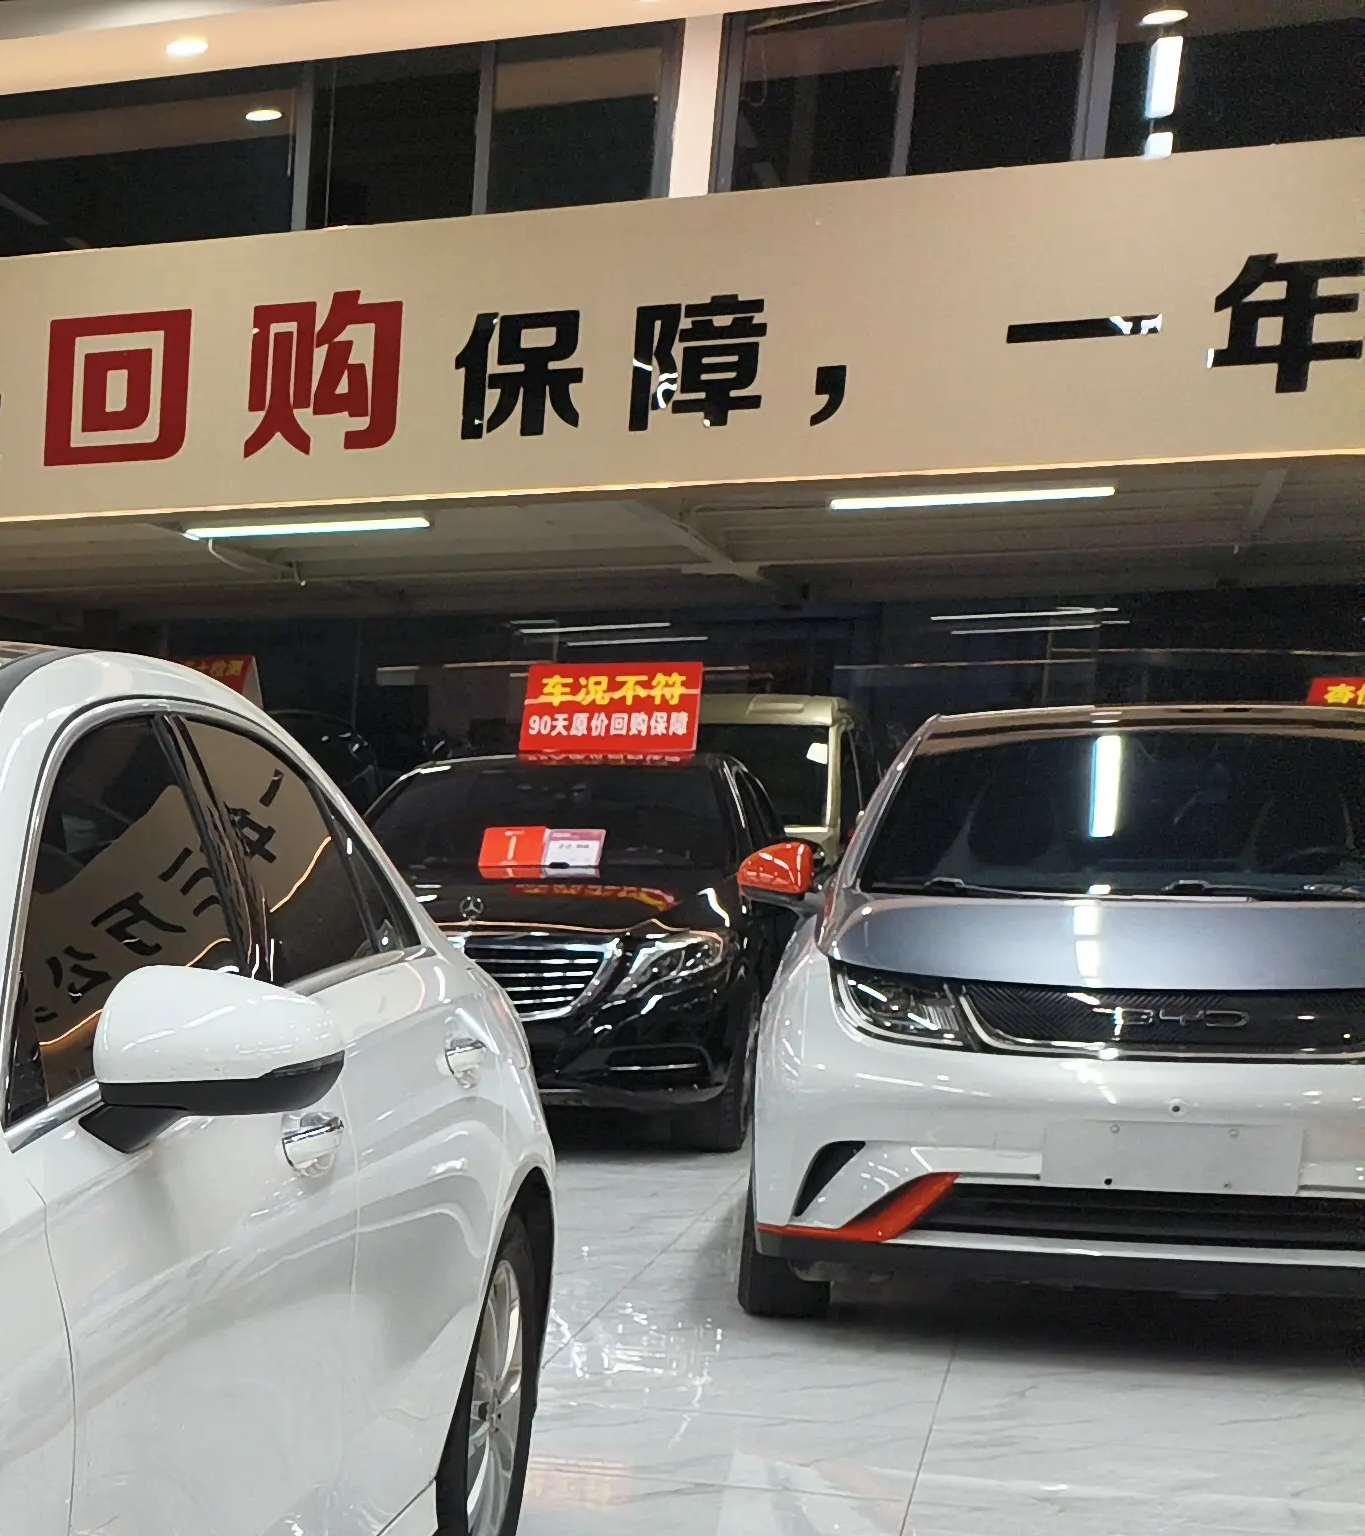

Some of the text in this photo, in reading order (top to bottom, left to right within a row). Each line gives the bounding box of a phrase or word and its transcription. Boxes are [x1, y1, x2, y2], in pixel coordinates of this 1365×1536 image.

[540, 672, 687, 706] 车况不符
[528, 711, 689, 737] 90天原价回购保障
